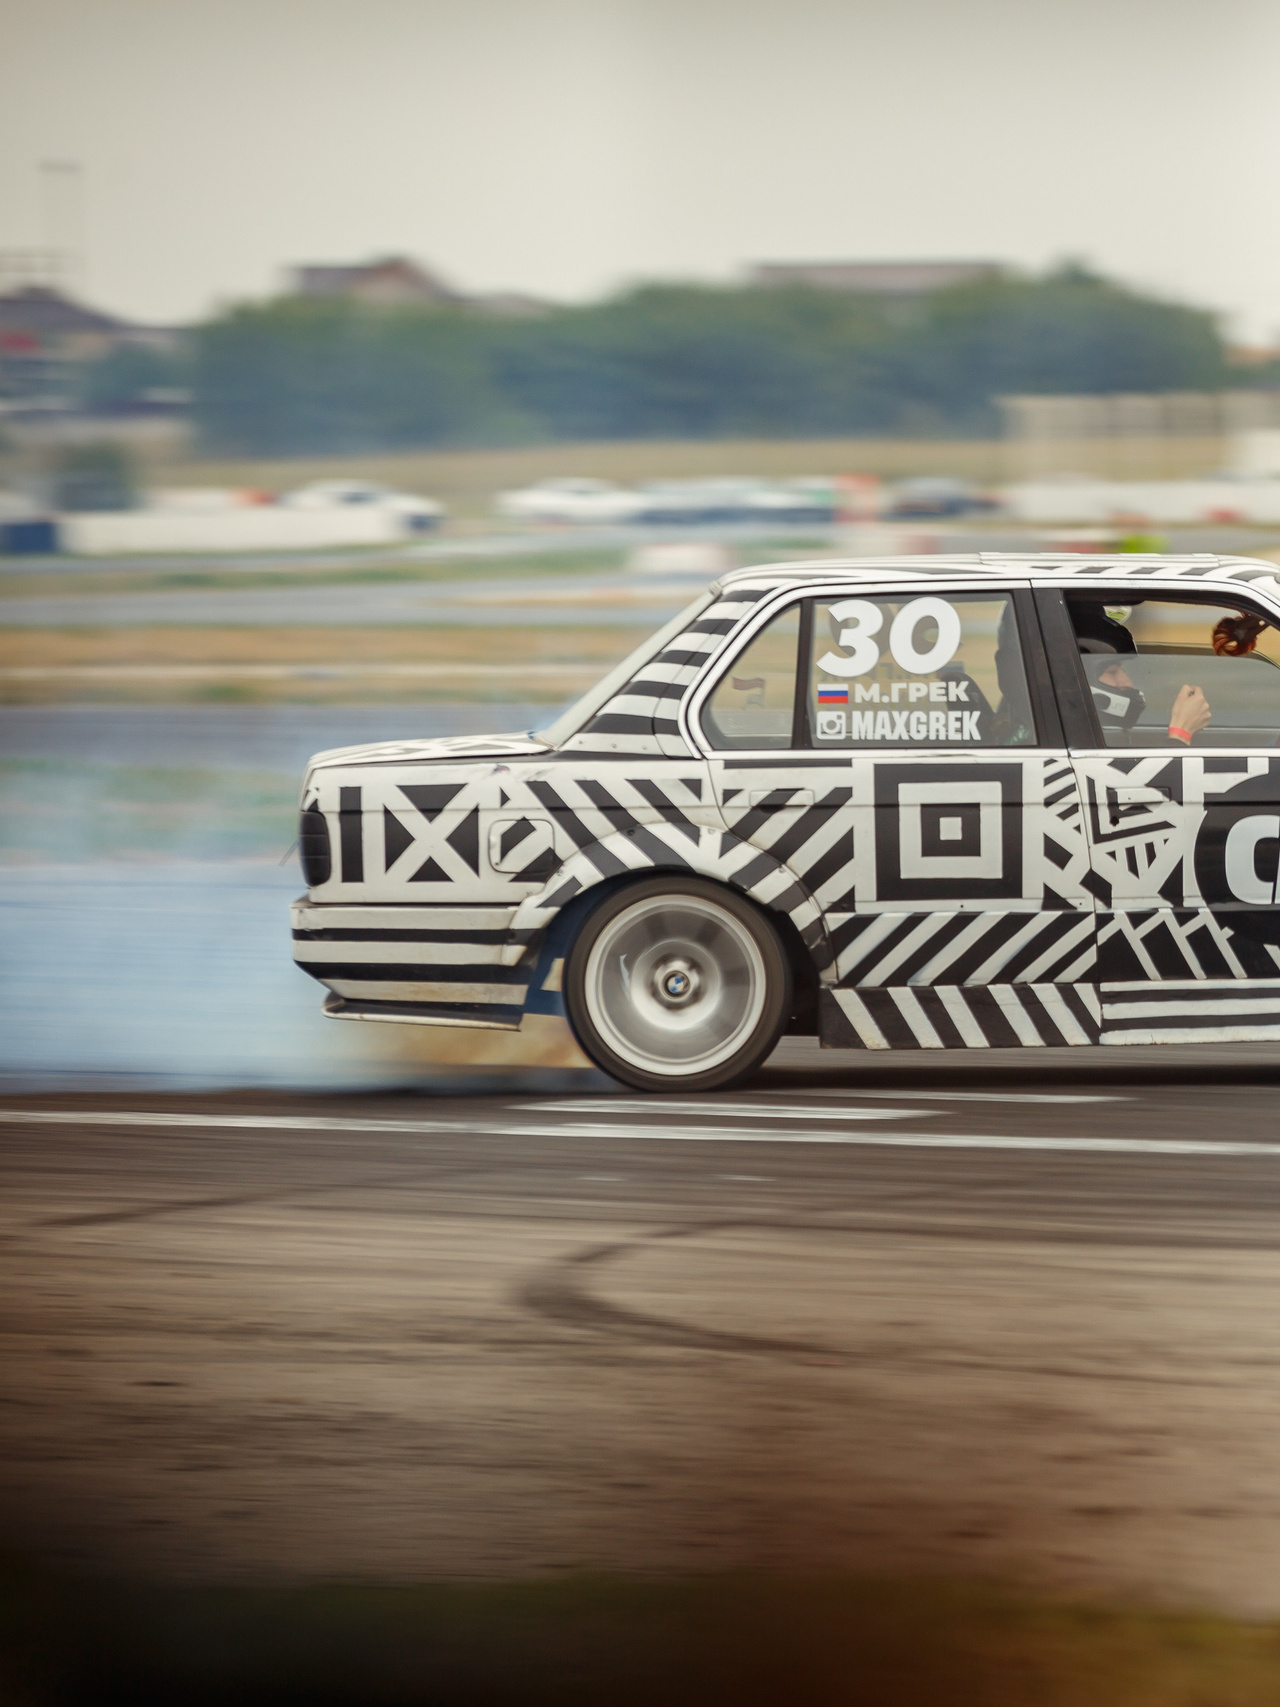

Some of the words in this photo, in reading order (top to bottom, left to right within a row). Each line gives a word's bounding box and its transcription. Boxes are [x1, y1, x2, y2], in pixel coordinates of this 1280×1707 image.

[816, 596, 962, 678] 30
[854, 681, 970, 704] М.ГРЕК
[851, 710, 982, 741] MAXGREK
